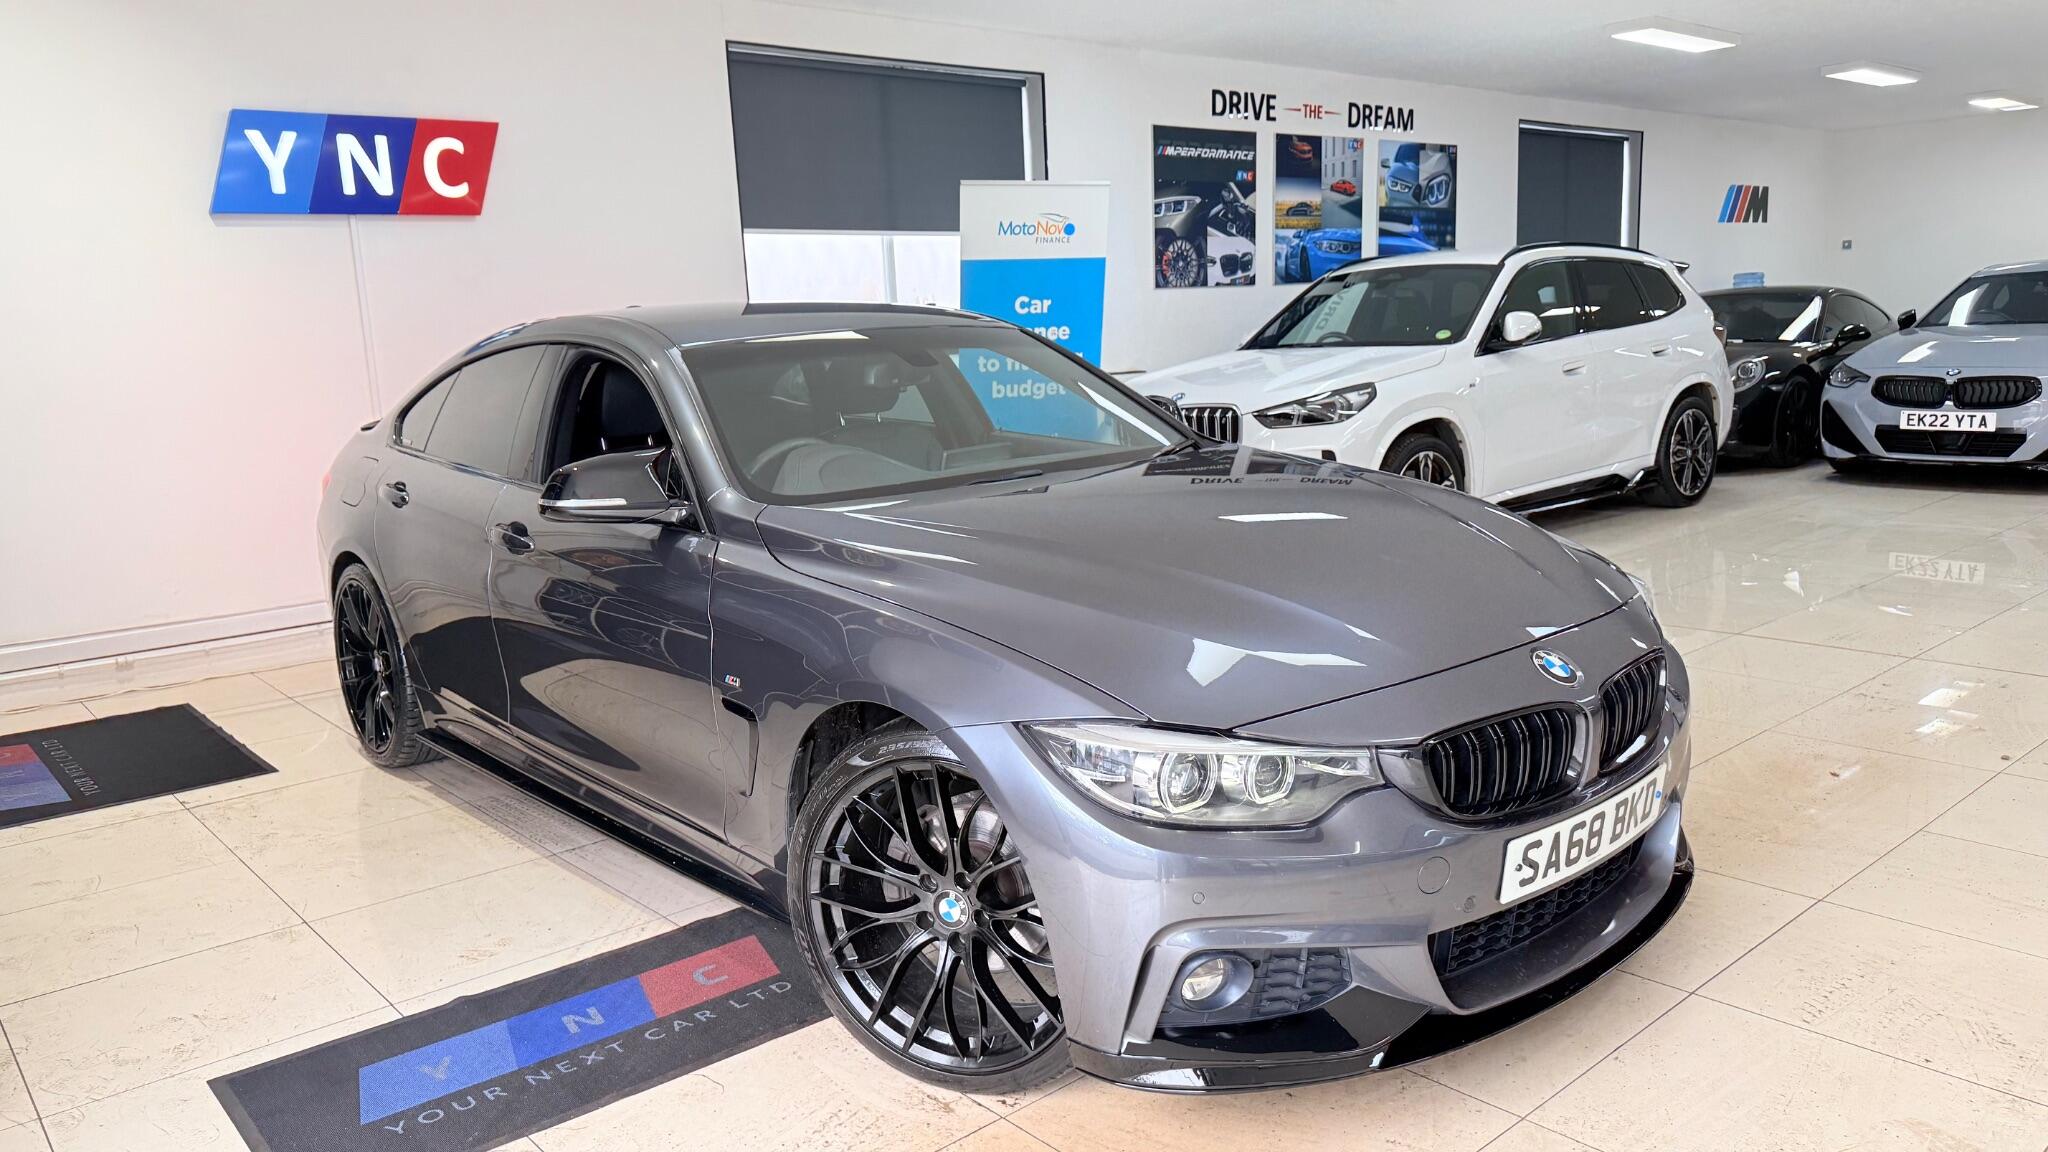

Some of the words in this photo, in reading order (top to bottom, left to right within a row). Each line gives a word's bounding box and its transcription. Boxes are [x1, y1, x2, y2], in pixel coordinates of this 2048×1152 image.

[1211, 89, 1277, 121] DRIVE
[1303, 104, 1323, 119] THE
[1348, 102, 1414, 132] DREAM
[244, 129, 469, 198] YNC
[1035, 236, 1071, 245] FINANCE
[1014, 295, 1052, 315] Car
[977, 355, 1000, 373] to
[1906, 413, 1950, 428] EK22
[1955, 414, 1988, 429] YTA
[1519, 810, 1606, 888] SA68
[1609, 777, 1657, 845] BKD
[384, 1086, 508, 1135] YOUR
[524, 1040, 624, 1086] NEXT
[644, 1010, 717, 1040] CAR
[729, 981, 792, 1009] LTD
